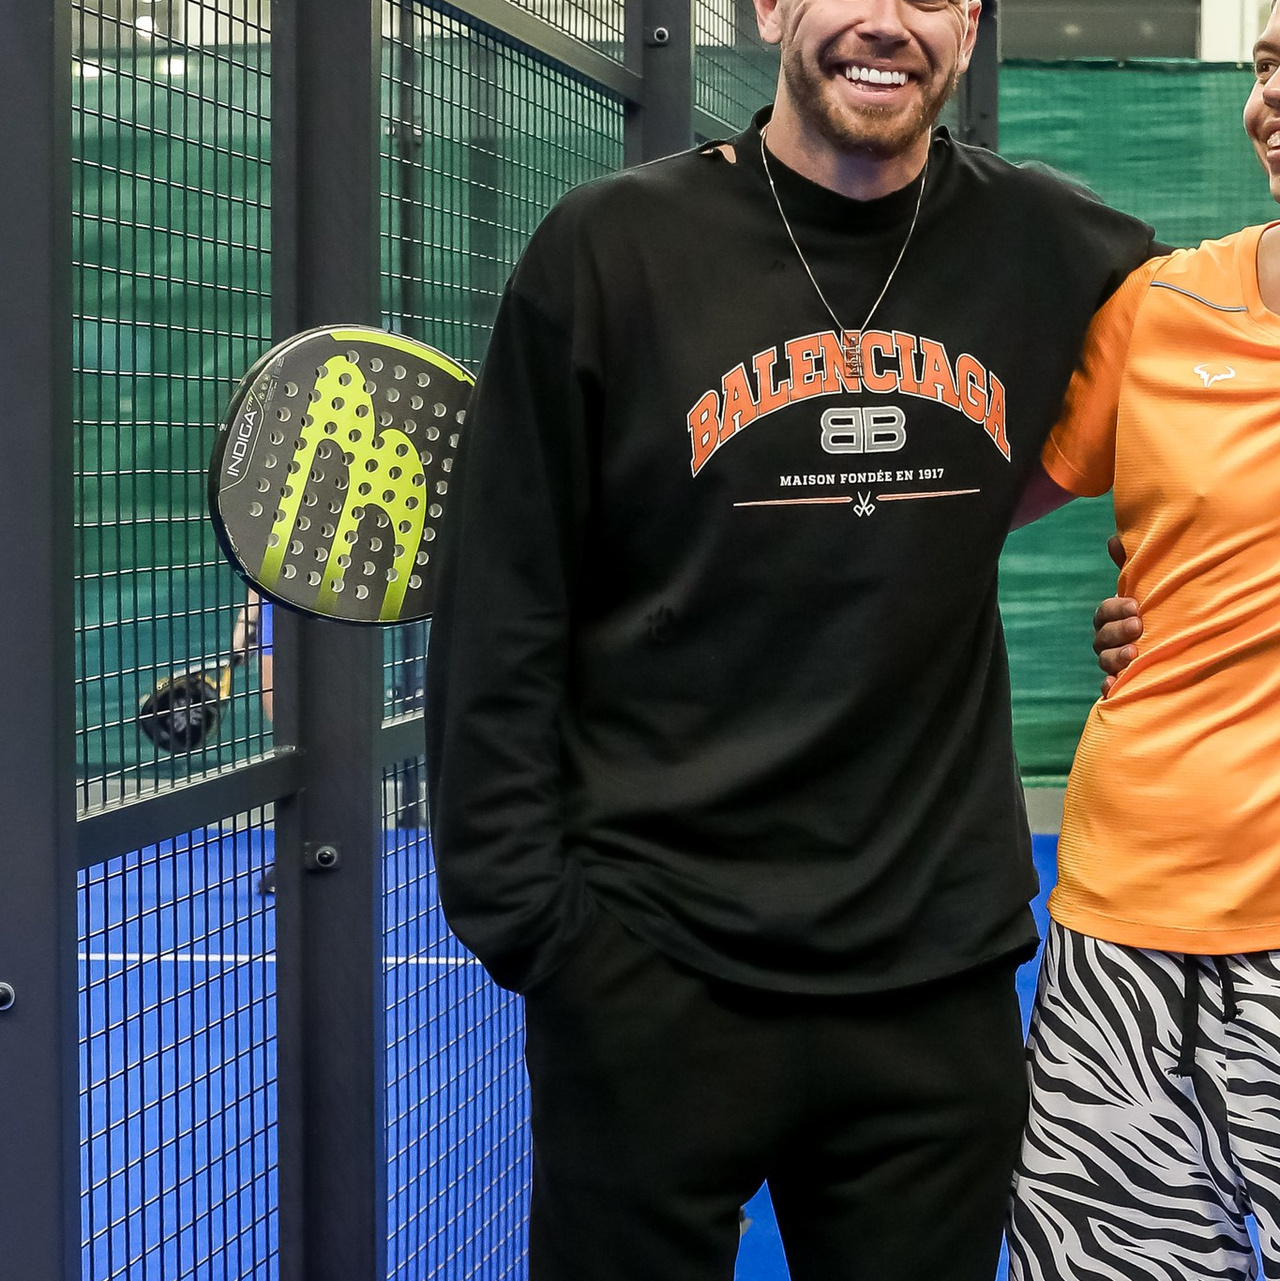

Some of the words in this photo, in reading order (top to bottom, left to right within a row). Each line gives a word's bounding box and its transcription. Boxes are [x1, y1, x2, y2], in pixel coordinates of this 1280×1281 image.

[687, 329, 1011, 478] BALENCIAGA
[227, 411, 257, 477] INDIGA
[779, 473, 836, 487] MAISON
[840, 469, 893, 484] FONDÉE
[896, 470, 914, 481] EN
[919, 468, 945, 480] 1917
